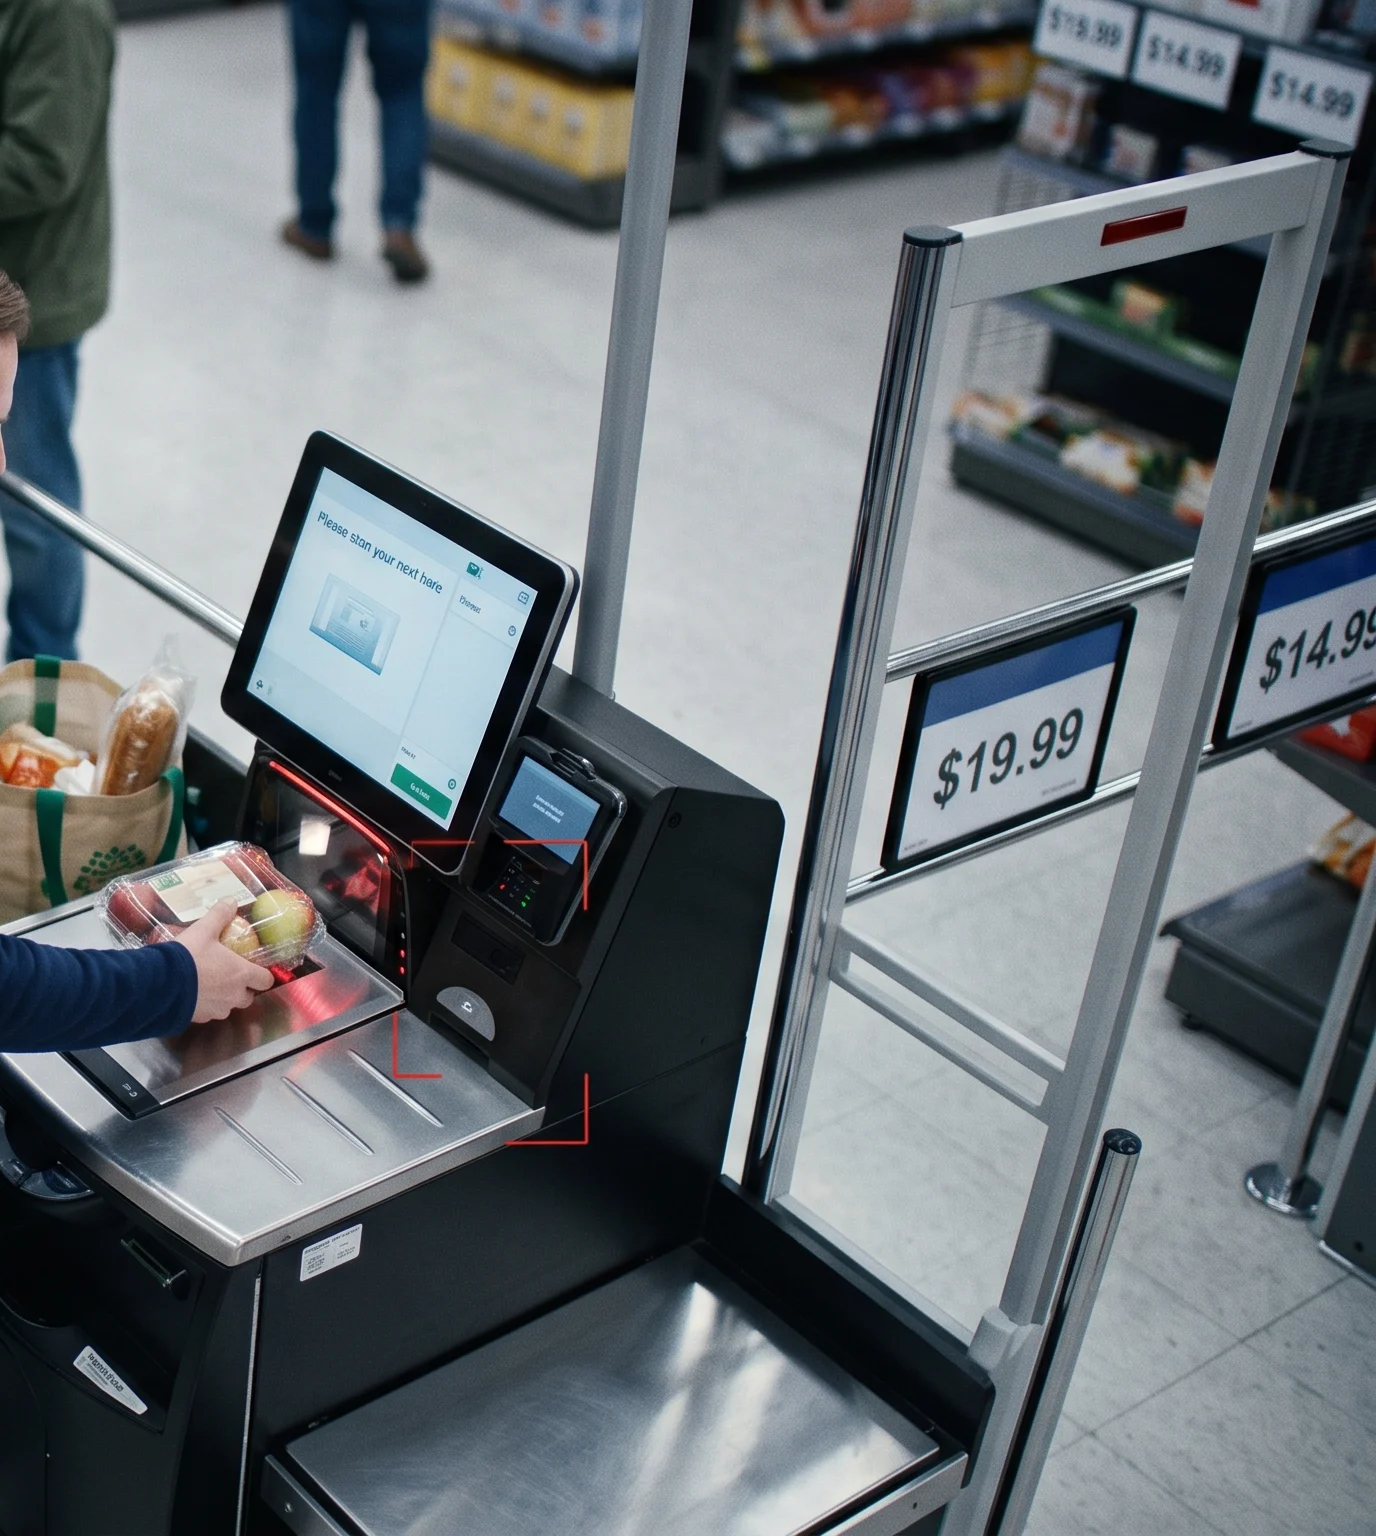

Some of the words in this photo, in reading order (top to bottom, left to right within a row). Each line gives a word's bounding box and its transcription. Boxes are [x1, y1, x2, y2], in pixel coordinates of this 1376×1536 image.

[1270, 70, 1355, 119] $14.99
[317, 510, 348, 538] Please
[372, 546, 395, 566] your
[396, 560, 419, 580] next
[933, 707, 1084, 811] $19.99
